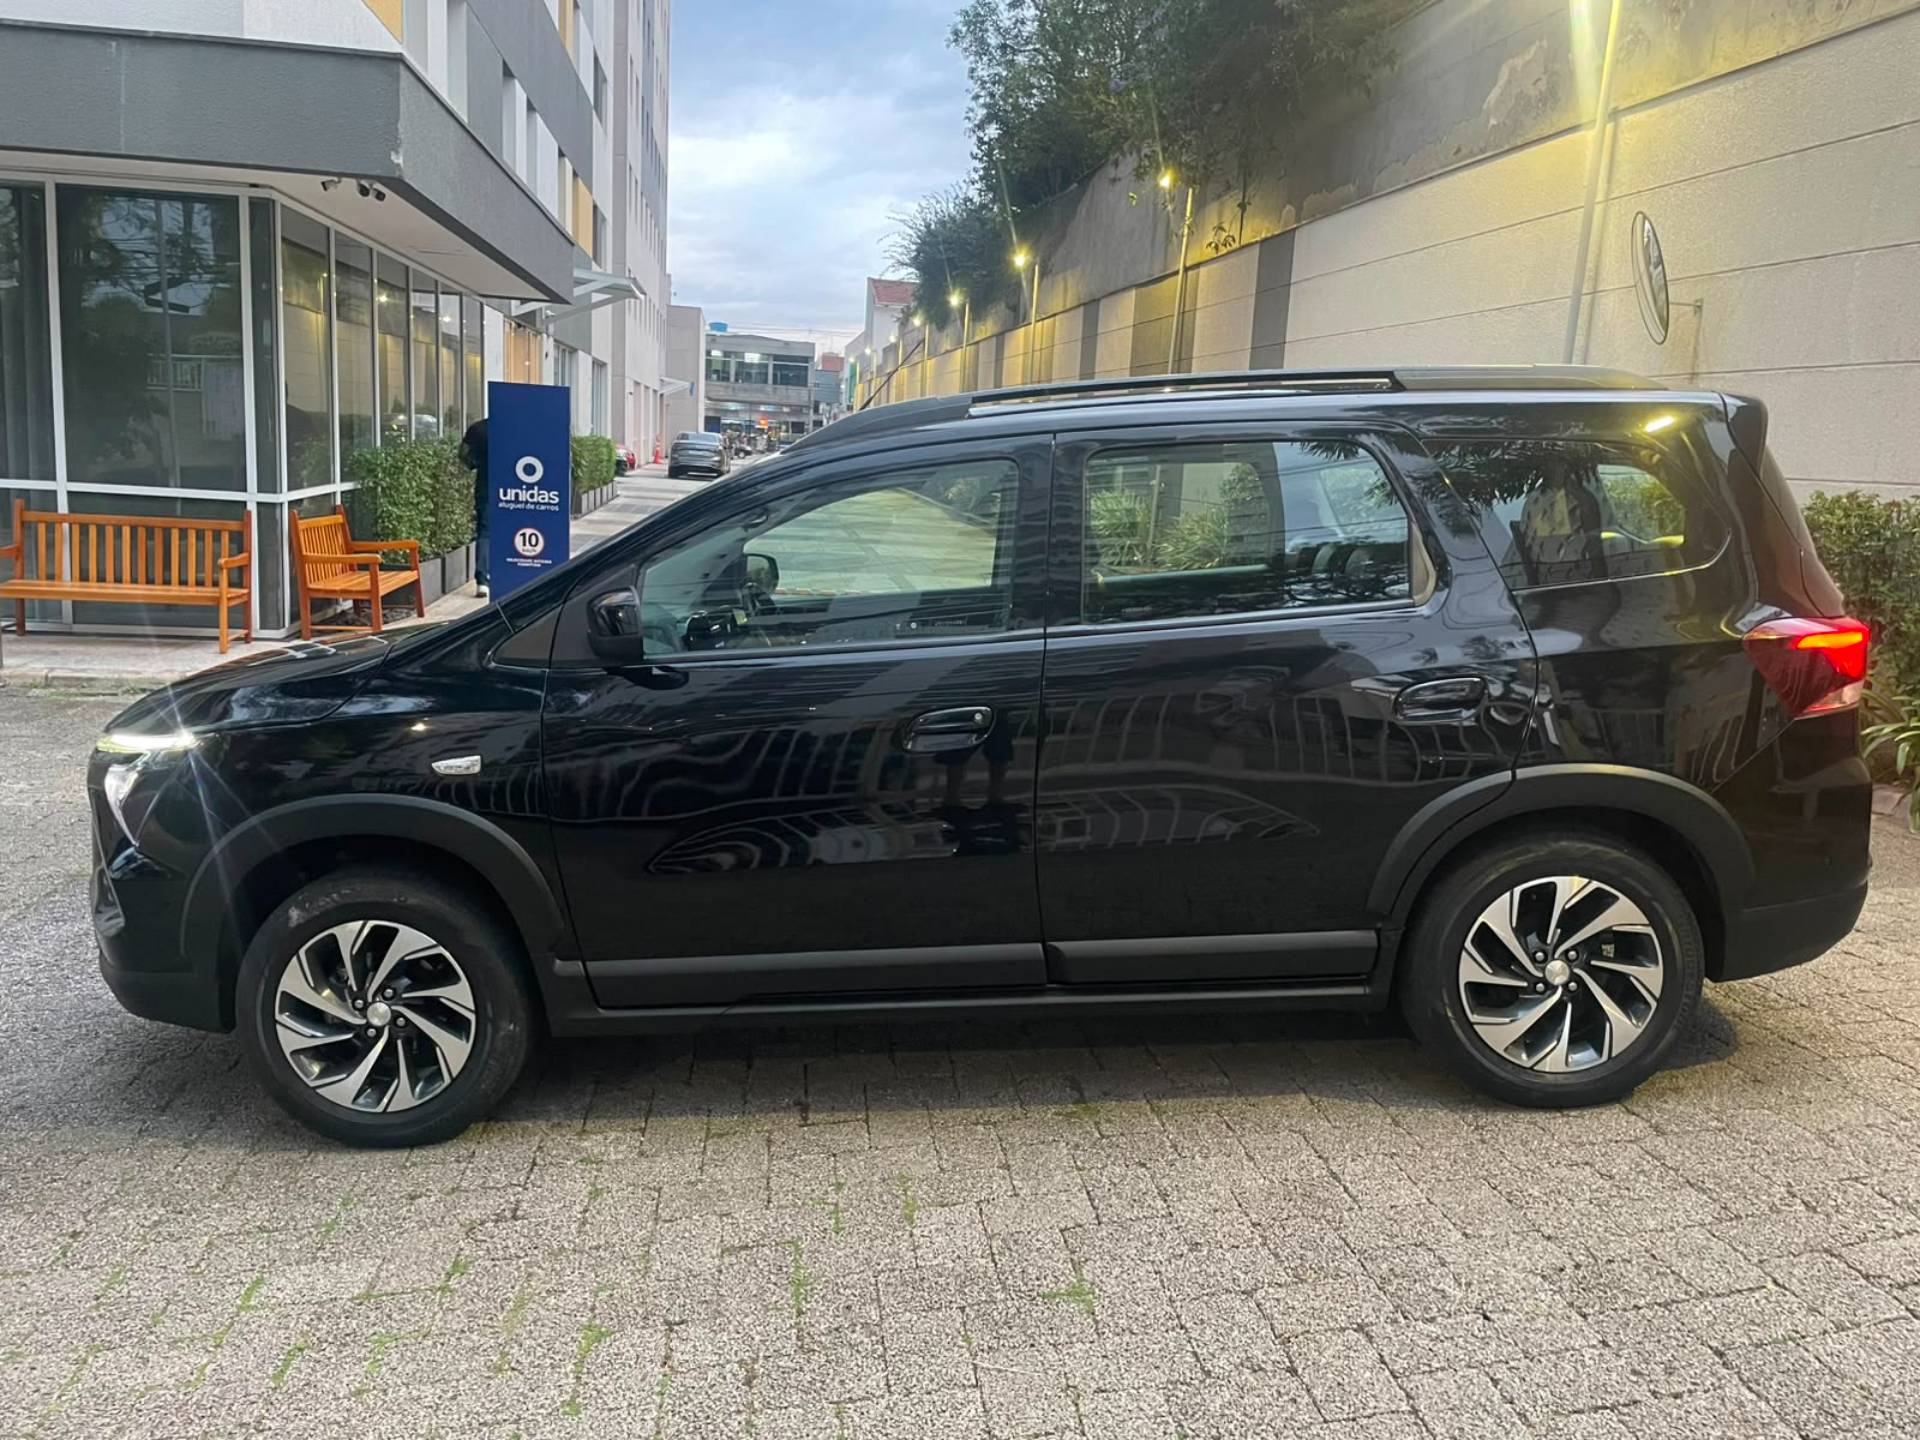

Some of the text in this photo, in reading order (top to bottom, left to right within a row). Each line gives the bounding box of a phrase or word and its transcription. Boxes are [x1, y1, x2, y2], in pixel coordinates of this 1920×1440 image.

[499, 485, 559, 503] unidas
[498, 502, 525, 510] aluguel
[519, 532, 539, 547] 10
